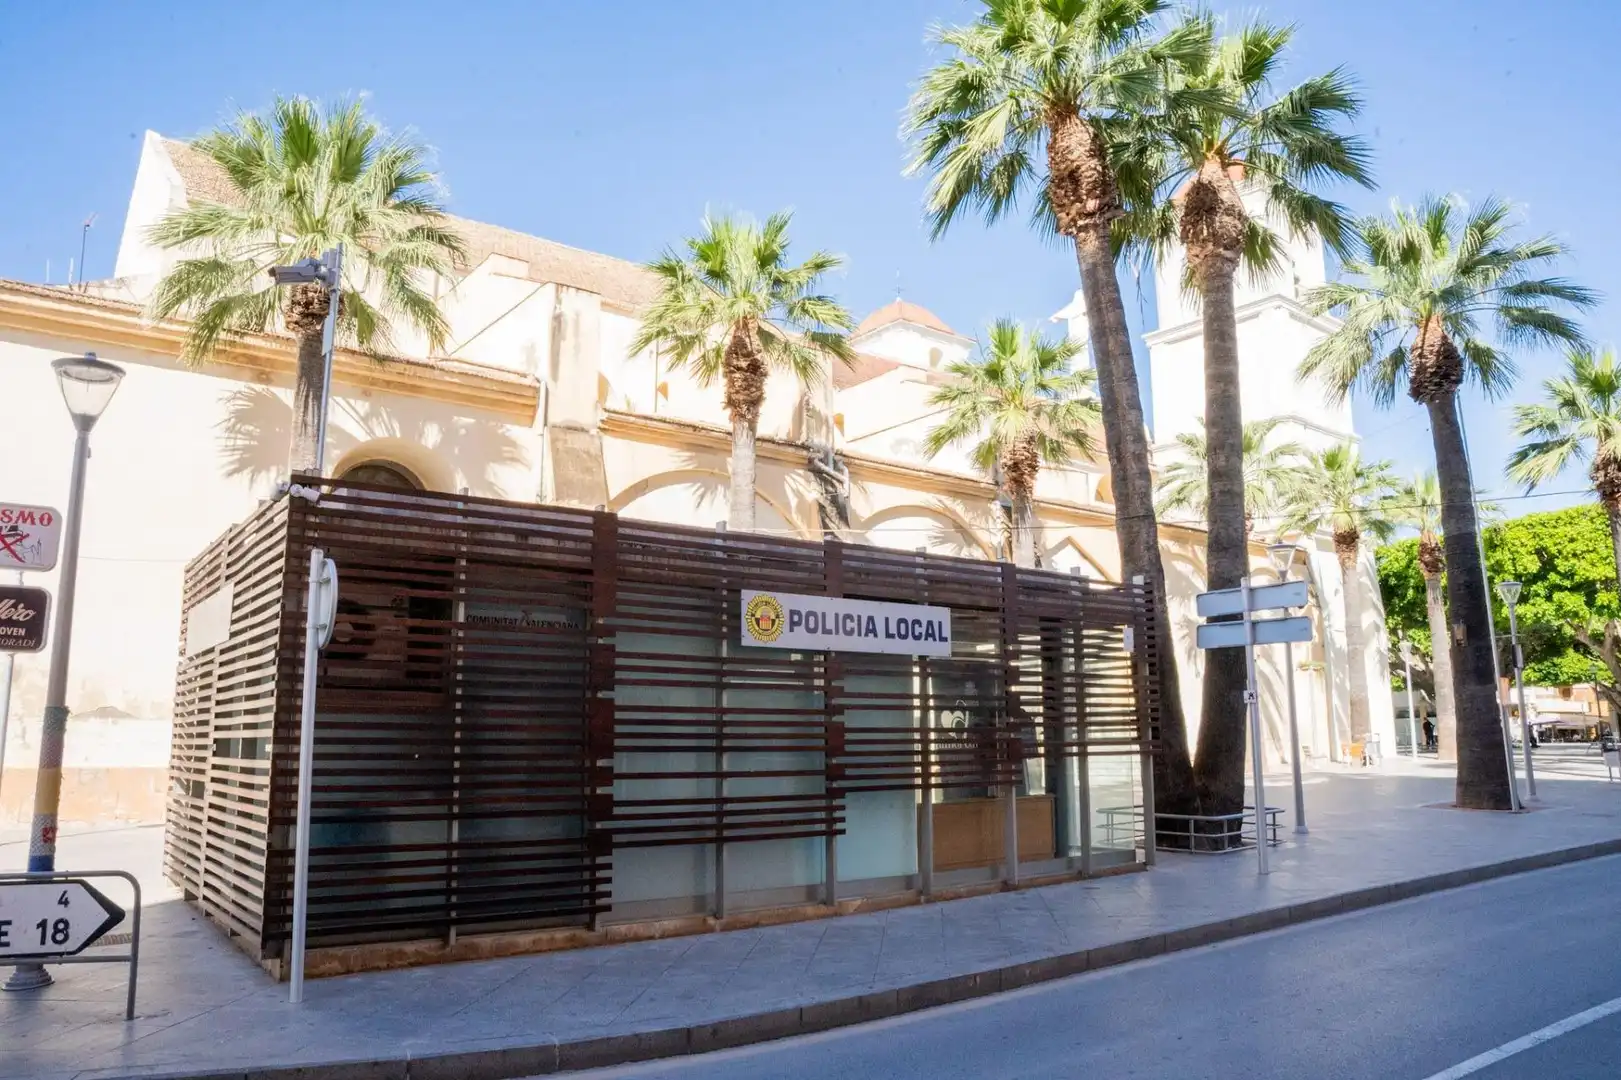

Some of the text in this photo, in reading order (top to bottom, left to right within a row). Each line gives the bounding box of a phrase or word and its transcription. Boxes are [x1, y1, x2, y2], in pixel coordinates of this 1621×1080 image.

[466, 614, 580, 629] COMUNITAT VALENCIANA
[789, 609, 948, 642] POLICIA LOCAL
[0, 638, 36, 647] ORADÍ
[57, 890, 70, 908] 4
[0, 918, 70, 947] E 18
